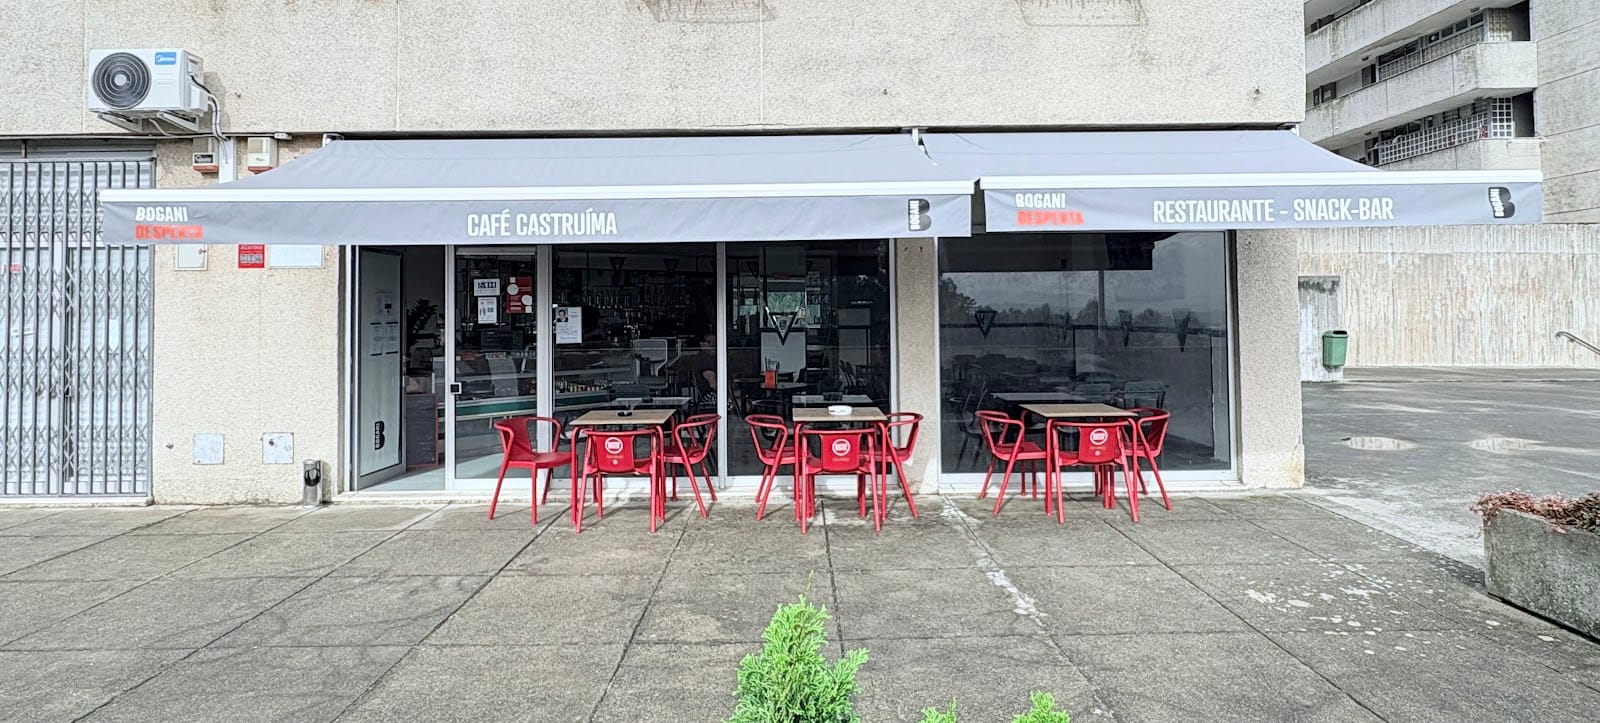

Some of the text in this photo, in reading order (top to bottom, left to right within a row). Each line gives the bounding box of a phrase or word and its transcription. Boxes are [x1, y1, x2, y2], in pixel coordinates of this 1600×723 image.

[135, 206, 189, 222] BOGANI
[1015, 192, 1066, 209] BOGANI
[1153, 198, 1275, 224] RESTAURANTE
[1293, 197, 1395, 222] SNACK-BAR
[1490, 189, 1505, 217] BOGANI
[467, 207, 618, 237] CAFÉ CASTRUÍMA
[909, 200, 920, 230] BOGANI
[135, 224, 204, 240] DESPERTA
